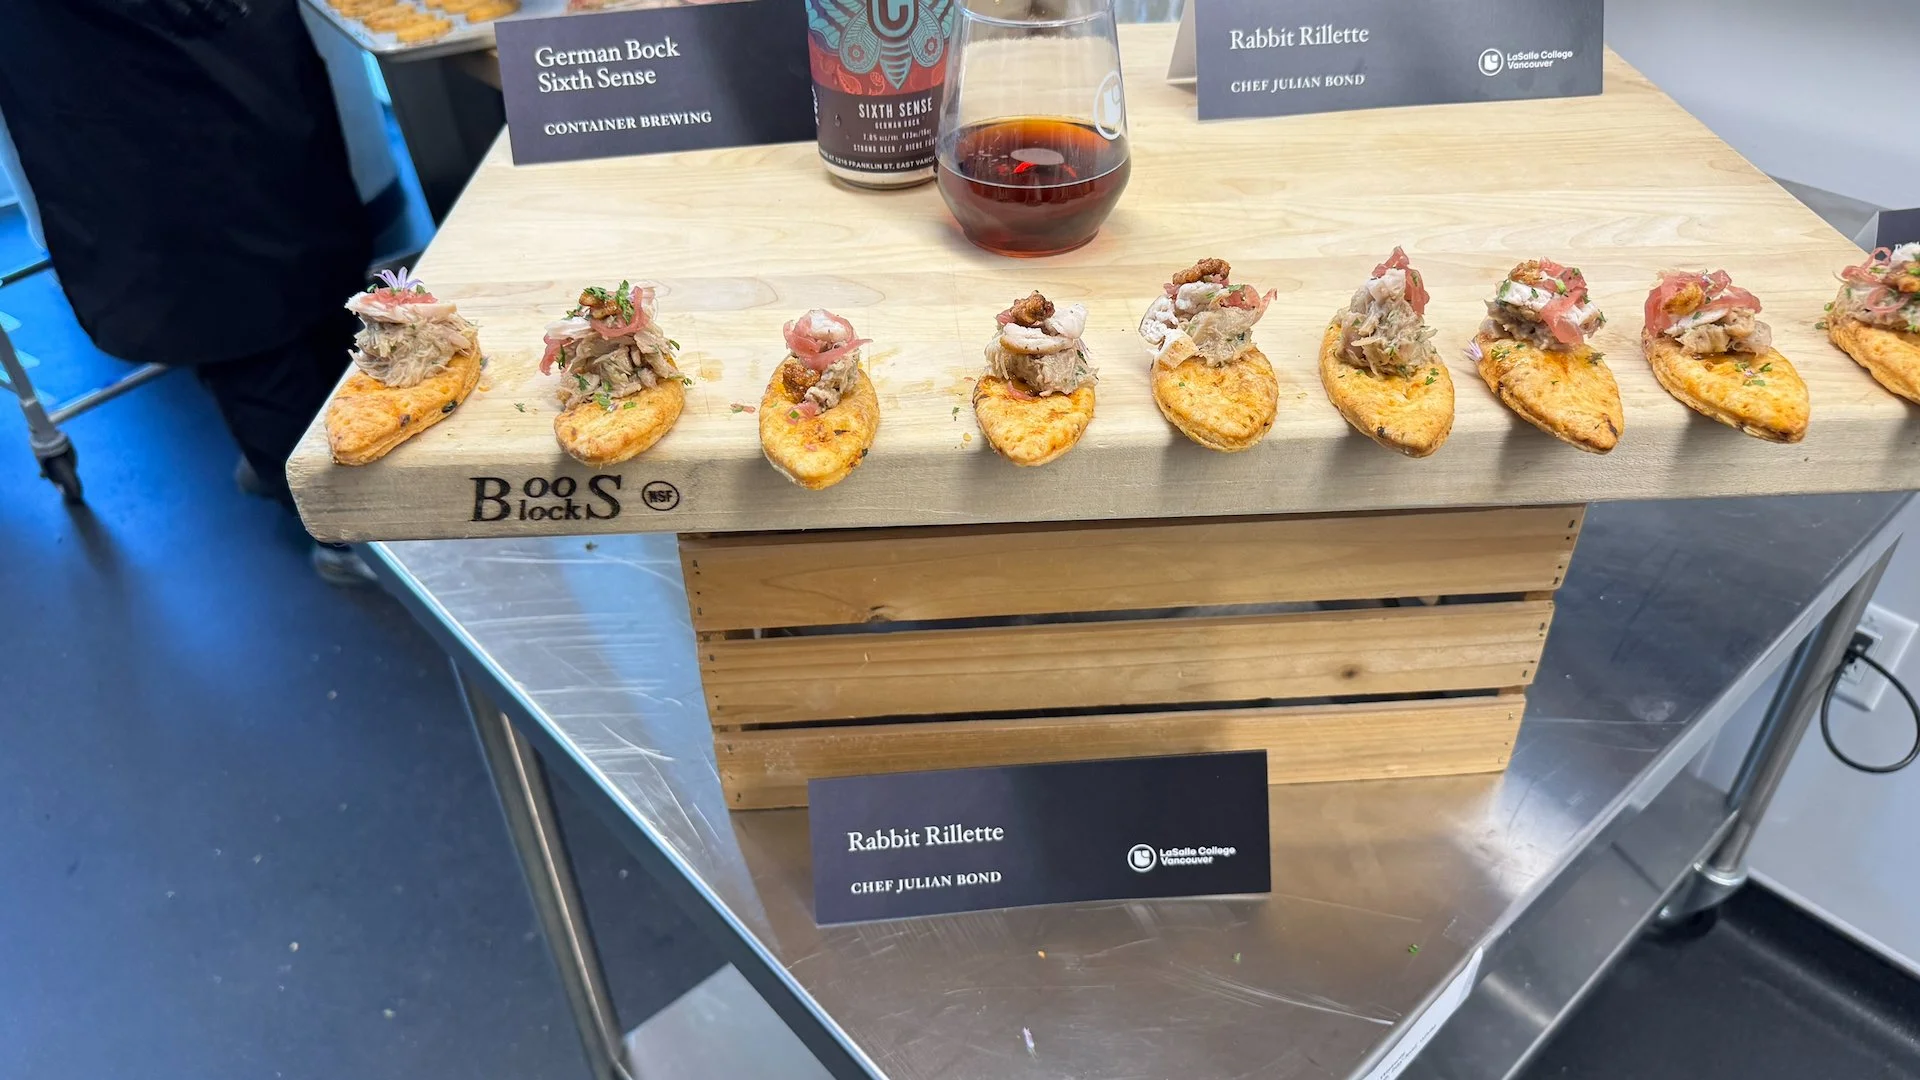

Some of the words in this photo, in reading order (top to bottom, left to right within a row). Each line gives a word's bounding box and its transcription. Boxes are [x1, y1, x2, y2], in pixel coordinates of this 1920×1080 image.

[1229, 27, 1295, 50] Rabbit
[1299, 24, 1369, 46] Rillette
[535, 46, 623, 68] German
[625, 36, 680, 60] Bock
[1507, 52, 1540, 61] LaSalle
[1540, 51, 1574, 60] College
[1507, 60, 1554, 70] Vancouver
[538, 68, 595, 93] Sixth
[597, 67, 657, 88] Sense
[1230, 80, 1269, 93] CHEF
[1271, 77, 1321, 93] JULIAN
[1325, 74, 1366, 87] BOND
[858, 103, 893, 119] SIXTH
[899, 97, 933, 117] SENSE
[544, 116, 637, 136] CONTAINER
[640, 111, 713, 128] BREWING
[874, 121, 902, 130] GERMAN
[903, 118, 920, 128] BOCK
[853, 143, 877, 153] STRONG
[880, 145, 896, 153] BEER
[848, 159, 882, 170] FRANKLIN
[896, 160, 914, 169] EAST
[915, 155, 935, 166] VANC
[648, 489, 673, 503] NSF
[847, 828, 920, 851] Rabbit
[924, 823, 1004, 846] Rillette
[1159, 847, 1197, 857] LaSalle
[1197, 846, 1237, 857] College
[1160, 856, 1214, 866] Vancouver
[850, 879, 894, 894] CHEF
[896, 874, 951, 893] JULIAN
[956, 871, 1002, 886] BOND
